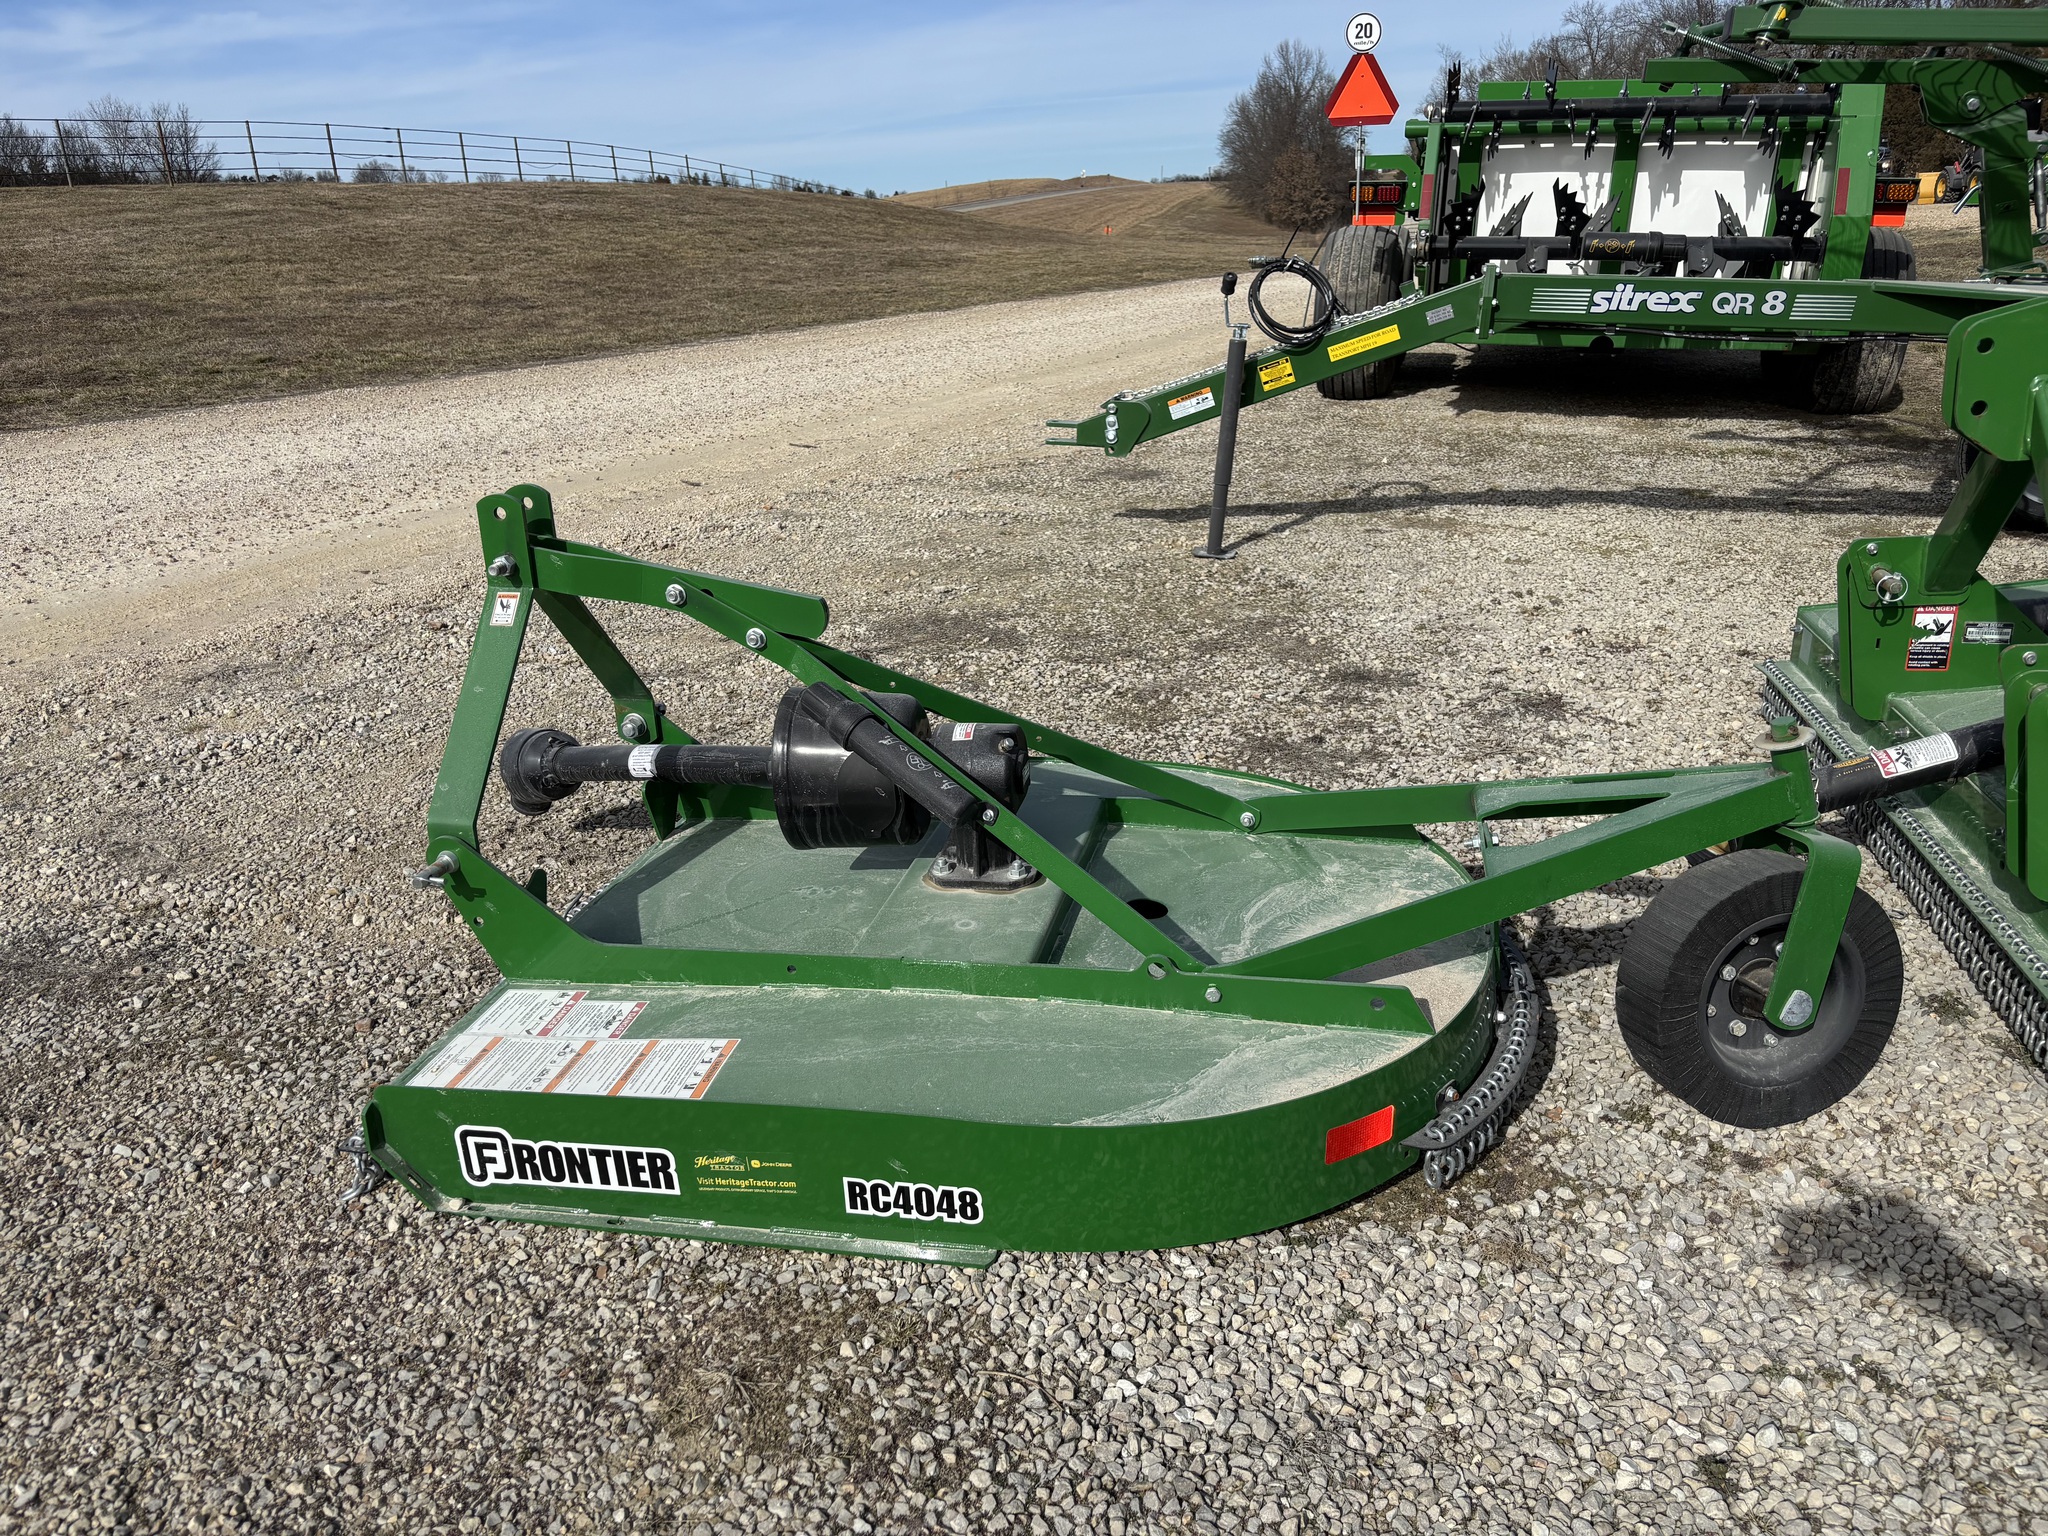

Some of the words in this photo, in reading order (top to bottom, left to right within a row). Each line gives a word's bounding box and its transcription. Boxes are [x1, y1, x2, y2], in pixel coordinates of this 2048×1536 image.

[1355, 22, 1373, 39] 20
[1589, 283, 1703, 314] sitrex
[1712, 292, 1755, 316] QR
[1761, 290, 1787, 315] 8
[1330, 342, 1356, 353] MAXIMUM
[1355, 335, 1372, 345] SPEED
[1371, 332, 1382, 341] FOR
[1381, 327, 1396, 337] ROAD
[1331, 348, 1360, 360] TRANSPORT
[1179, 390, 1203, 402] WARNING
[545, 1006, 571, 1028] DANGER
[612, 1012, 637, 1034] DANGER
[619, 1058, 642, 1081] WARNING
[701, 1059, 722, 1082] WARNING
[458, 1128, 676, 1191] FRONTIER
[694, 1155, 735, 1168] Heritage
[696, 1177, 714, 1185] Visit
[715, 1177, 796, 1188] HeritageTractor.com
[847, 1180, 980, 1221] RC4048
